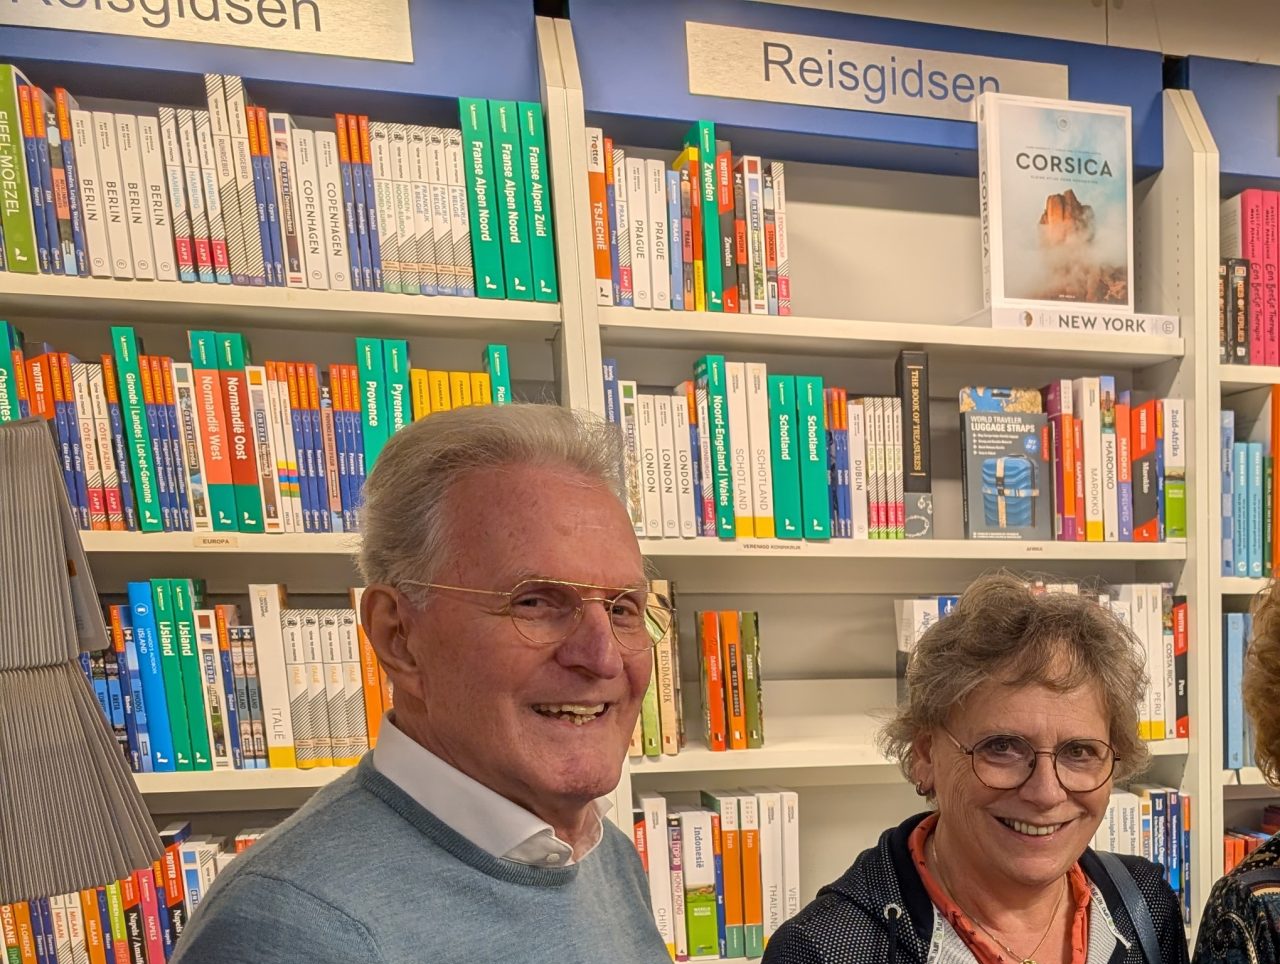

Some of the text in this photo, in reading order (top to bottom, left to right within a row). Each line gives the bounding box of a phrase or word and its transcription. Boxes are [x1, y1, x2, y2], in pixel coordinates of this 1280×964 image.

[763, 41, 1000, 104] Reisgidsen
[704, 162, 714, 201] Zweden
[1016, 152, 1113, 178] CORSICA
[84, 179, 97, 221] BERLIN
[107, 181, 120, 223] BERLIN
[128, 182, 142, 224] BERLIN
[150, 184, 165, 226] BERLIN
[171, 169, 181, 208] HAMBURG
[189, 170, 200, 209] HAMBURG
[208, 172, 217, 211] HAMBURG
[472, 141, 491, 242] Franse Alpen Noord
[501, 143, 521, 244] Franse Alpen Noord
[529, 147, 546, 237] Franse Alpen Zuid
[303, 180, 319, 255] COPENHAGEN
[327, 182, 342, 257] COPENHAGEN
[981, 169, 990, 259] CORSICA
[635, 220, 645, 260] PRAGUE
[655, 221, 664, 261] PRAGUE
[1059, 314, 1147, 334] NEW YORK
[34, 362, 44, 392] TROTTER
[203, 376, 222, 461] Normandië West
[227, 377, 247, 460] Normandië Oost
[366, 380, 378, 427] Provence
[971, 415, 1022, 425] WORLD TRAVELER
[126, 372, 153, 503] Gironde Landes Lot-et-Garonne
[779, 413, 791, 460] Schotland
[807, 415, 819, 461] Schotland
[913, 417, 921, 471] TREASURES
[971, 423, 1035, 433] LUGGAGE STRAPS
[1171, 409, 1180, 457] Zuid-Afrika
[645, 448, 656, 493] LONDON
[662, 449, 673, 494] LONDON
[713, 395, 729, 507] Noord-Engeland Wales
[1105, 440, 1115, 489] MAROKKO
[679, 450, 690, 495] LONDON
[736, 448, 748, 511] SCHOTLAND
[756, 448, 768, 511] SCHOTLAND
[855, 460, 863, 491] DUBLIN
[1091, 468, 1099, 516] MAROKKO
[139, 628, 147, 655] IJSLAND
[160, 621, 175, 657] IJsland
[179, 621, 193, 657] IJsland
[271, 708, 284, 740] ITALIË
[166, 851, 176, 879] TROTTER
[694, 827, 704, 868] Indonesië
[20, 923, 31, 958] FLORENCE
[55, 911, 65, 939] MILAAN
[69, 911, 78, 938] MILAAN
[89, 920, 98, 945] MILAAN
[129, 912, 138, 936] Napels
[148, 916, 157, 941] NAPELS
